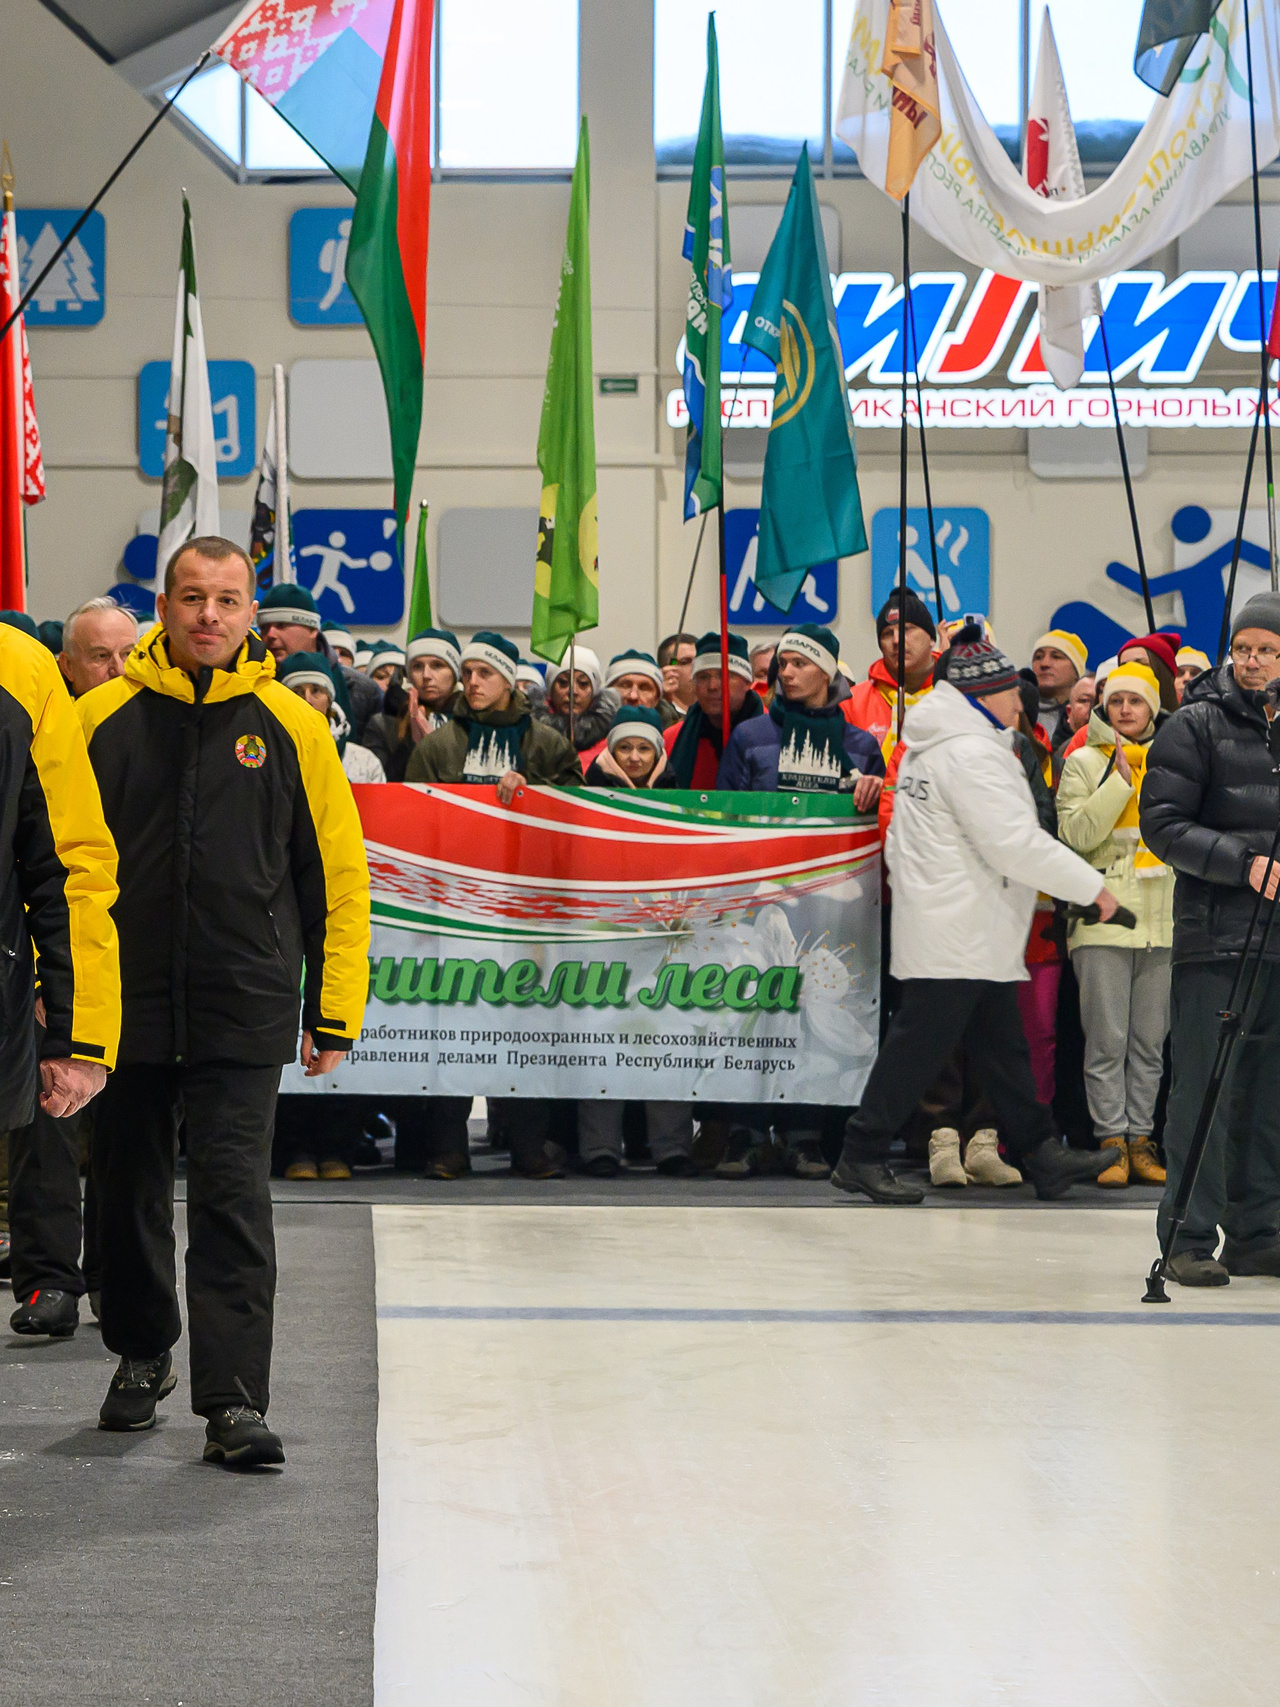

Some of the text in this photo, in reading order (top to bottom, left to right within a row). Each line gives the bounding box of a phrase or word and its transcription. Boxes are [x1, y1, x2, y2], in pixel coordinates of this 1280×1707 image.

[637, 962, 801, 1010] леса
[360, 1025, 797, 1048] работников природоохранных и лесохозяйственных
[437, 1052, 497, 1066] делами
[507, 1050, 607, 1068] Президента
[616, 1052, 715, 1071] Республики
[723, 1054, 796, 1074] Беларусь
